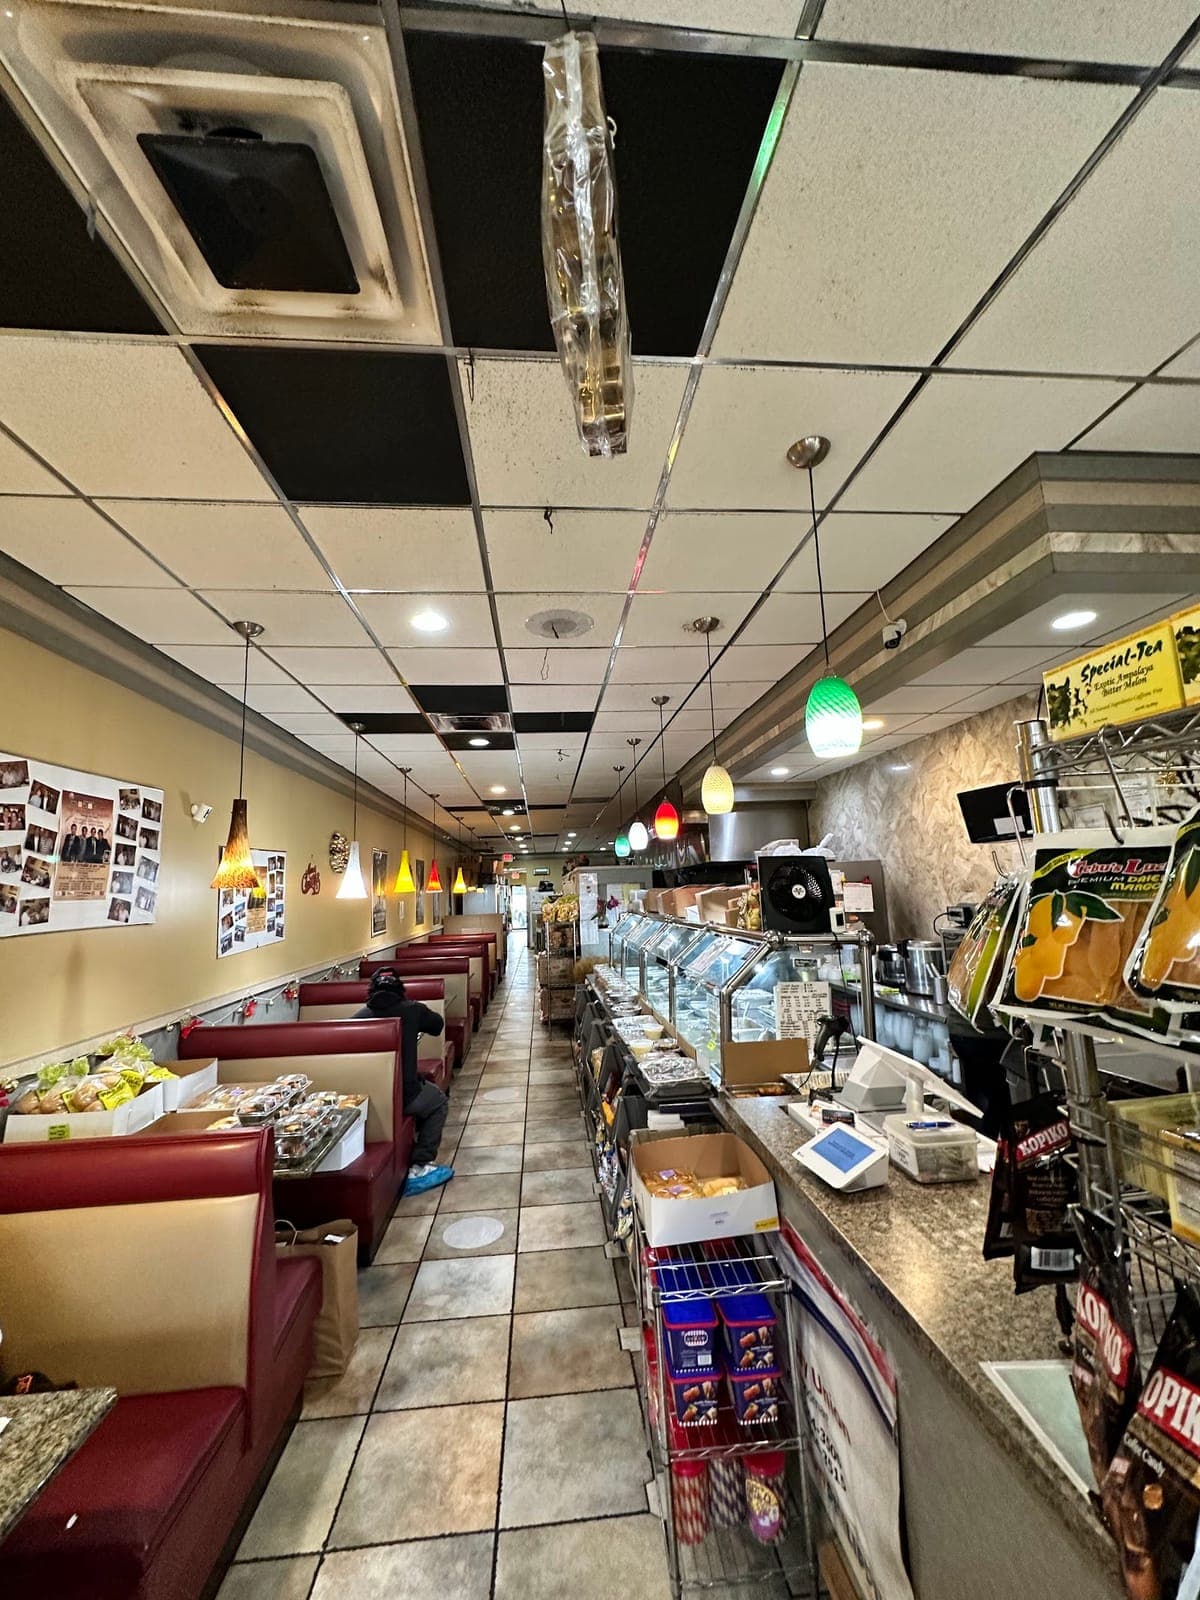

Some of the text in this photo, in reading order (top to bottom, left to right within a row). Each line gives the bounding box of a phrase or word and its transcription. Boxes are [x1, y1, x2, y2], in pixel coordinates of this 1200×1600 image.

[1081, 640, 1163, 683] Special-Tea
[1094, 664, 1154, 690] Exotic Ampalaya
[1102, 677, 1147, 697] Bitter Melon
[1017, 1122, 1068, 1156] KOPIKO
[1139, 1370, 1200, 1448] OPIK
[1123, 1431, 1143, 1457] Coffee
[1142, 1448, 1166, 1478] Candy
